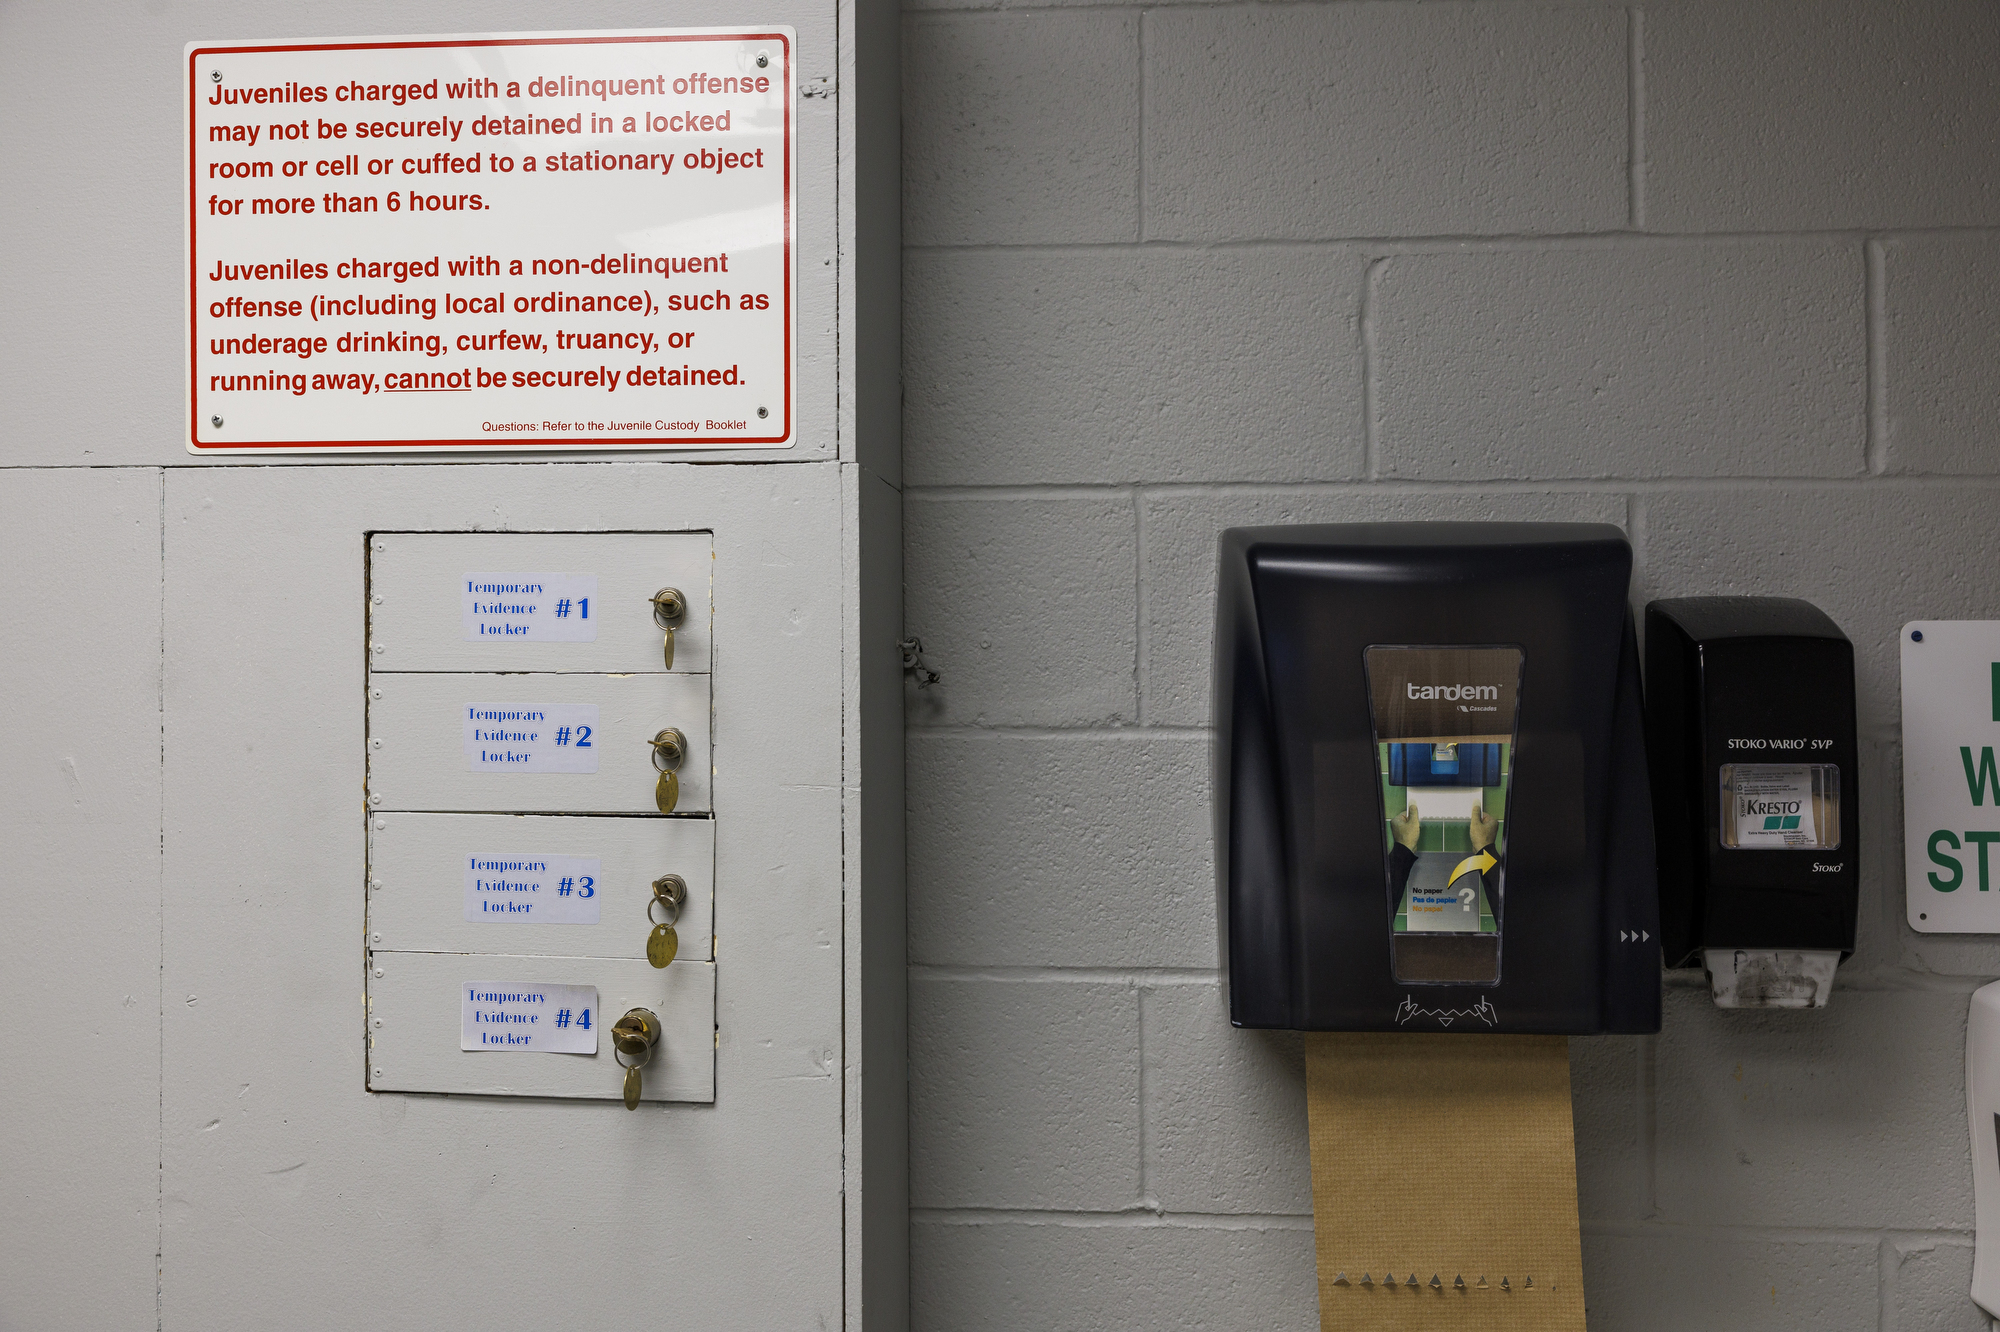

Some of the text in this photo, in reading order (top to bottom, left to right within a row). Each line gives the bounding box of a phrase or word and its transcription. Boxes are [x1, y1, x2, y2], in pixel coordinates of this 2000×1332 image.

[209, 73, 769, 106] Juveniles charged with a delinquent offense
[210, 110, 730, 146] may not be securely detained in a locked
[210, 148, 763, 178] room or cell or cuffed to a stationary object
[209, 191, 489, 215] for more than 6 hours.
[209, 253, 728, 283] Juveniles charged with a non-delinquent
[210, 290, 769, 321] offense (including local ordinance), such as
[211, 329, 695, 359] underage drinking, curfew, truancy, or
[211, 364, 745, 396] running away, cannot be securely detained.
[482, 420, 746, 432] Questions: Refer to the Juvenile Custody Booklet
[467, 580, 545, 596] Temporary
[473, 601, 537, 615] Evidence
[554, 597, 589, 620] #1
[480, 622, 530, 636] Locker
[1407, 683, 1498, 701] tandem
[468, 707, 545, 724] Temporary
[475, 728, 539, 742] Evidence
[554, 725, 593, 748] #2
[1728, 739, 1767, 749] STOKO
[1810, 739, 1834, 750] SVP
[481, 749, 532, 763] Locker
[470, 858, 547, 874] Temporary
[476, 879, 540, 893] Evidence
[556, 876, 595, 899] #3
[483, 900, 533, 914] Locker
[467, 989, 547, 1006] Temporary
[475, 1010, 539, 1025] Evidence
[554, 1008, 593, 1031] #4
[482, 1031, 532, 1046] Locker
